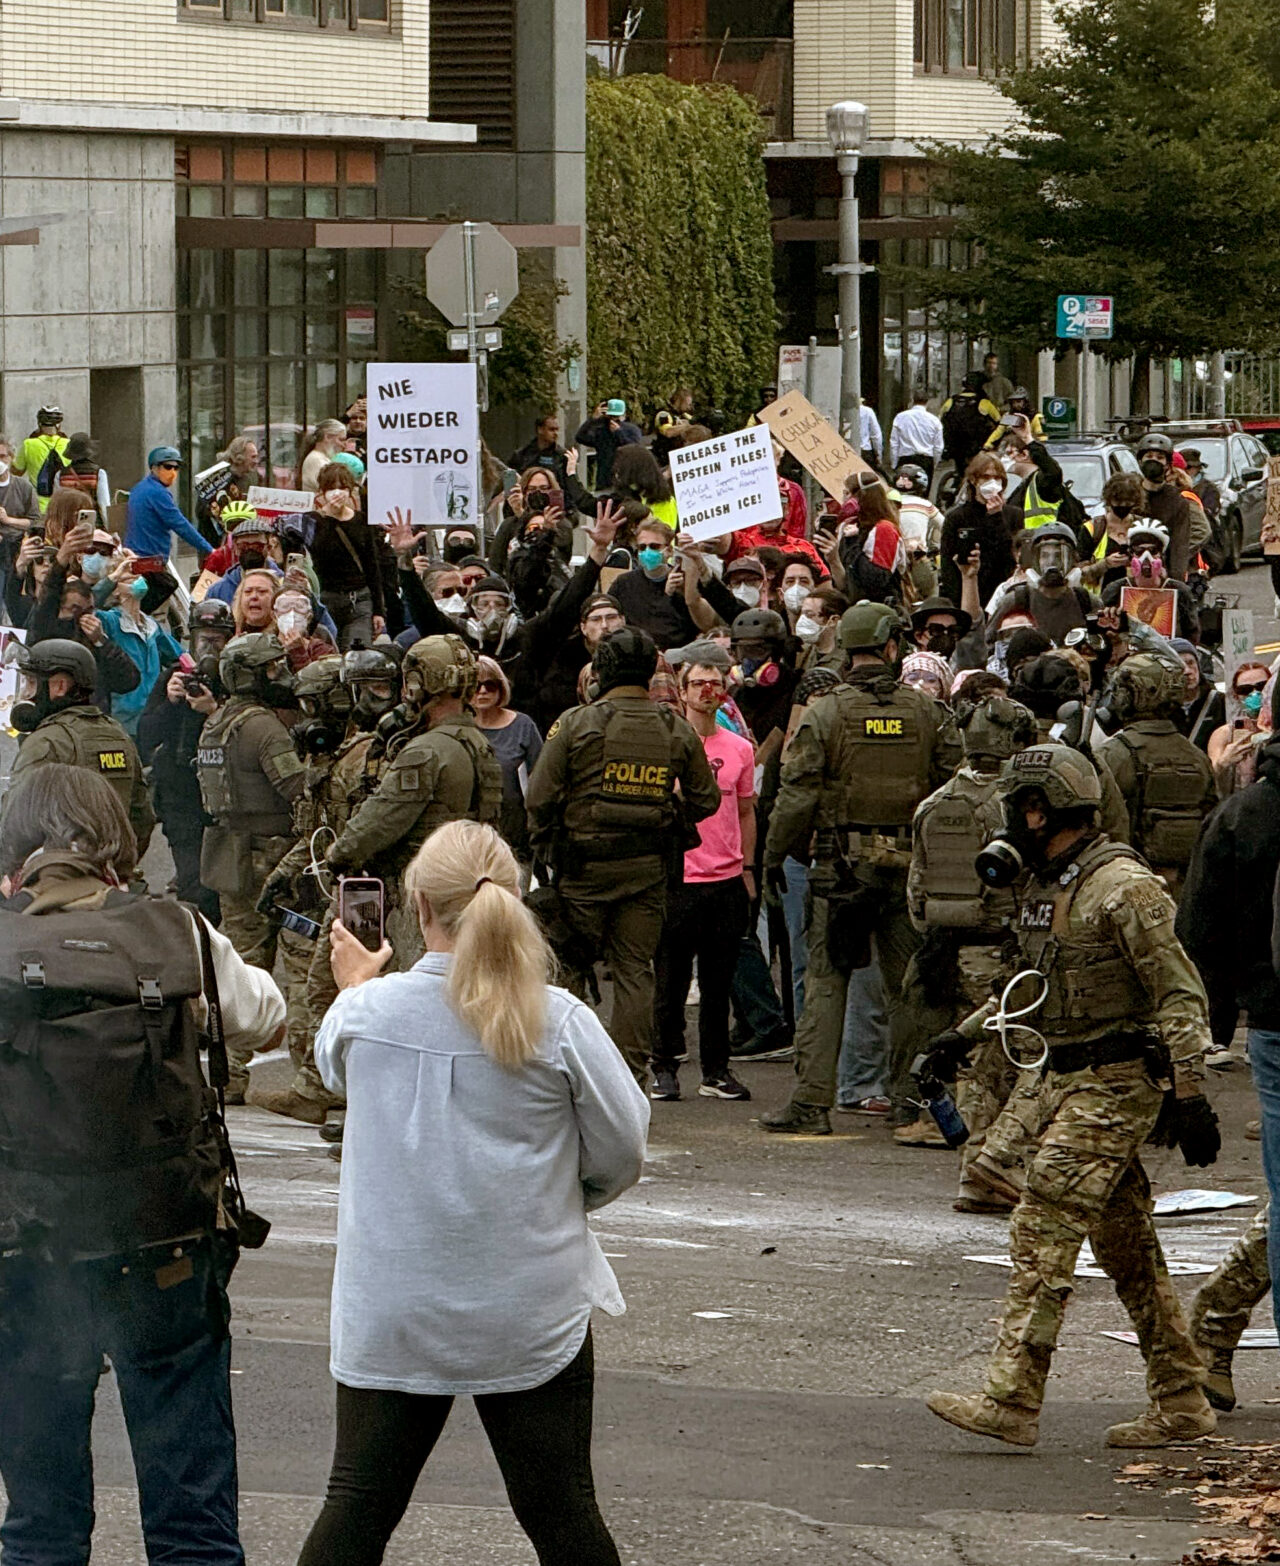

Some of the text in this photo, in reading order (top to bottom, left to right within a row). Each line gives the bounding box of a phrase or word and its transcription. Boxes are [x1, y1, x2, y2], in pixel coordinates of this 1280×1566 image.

[378, 379, 413, 400] NIE
[378, 411, 459, 429] WIEDER
[780, 412, 825, 443] CHINGA
[677, 433, 756, 465] RELEASE THE
[799, 438, 824, 452] LA
[375, 448, 468, 465] GESTAPO
[676, 447, 767, 483] EPSTEIN FILES!
[808, 444, 857, 476] MIGRA
[682, 493, 762, 528] ABOLISH ICE!
[865, 719, 903, 734] POLICE
[99, 752, 126, 769] POLICE
[1014, 752, 1051, 768] POLICE
[604, 762, 669, 785] POLICE
